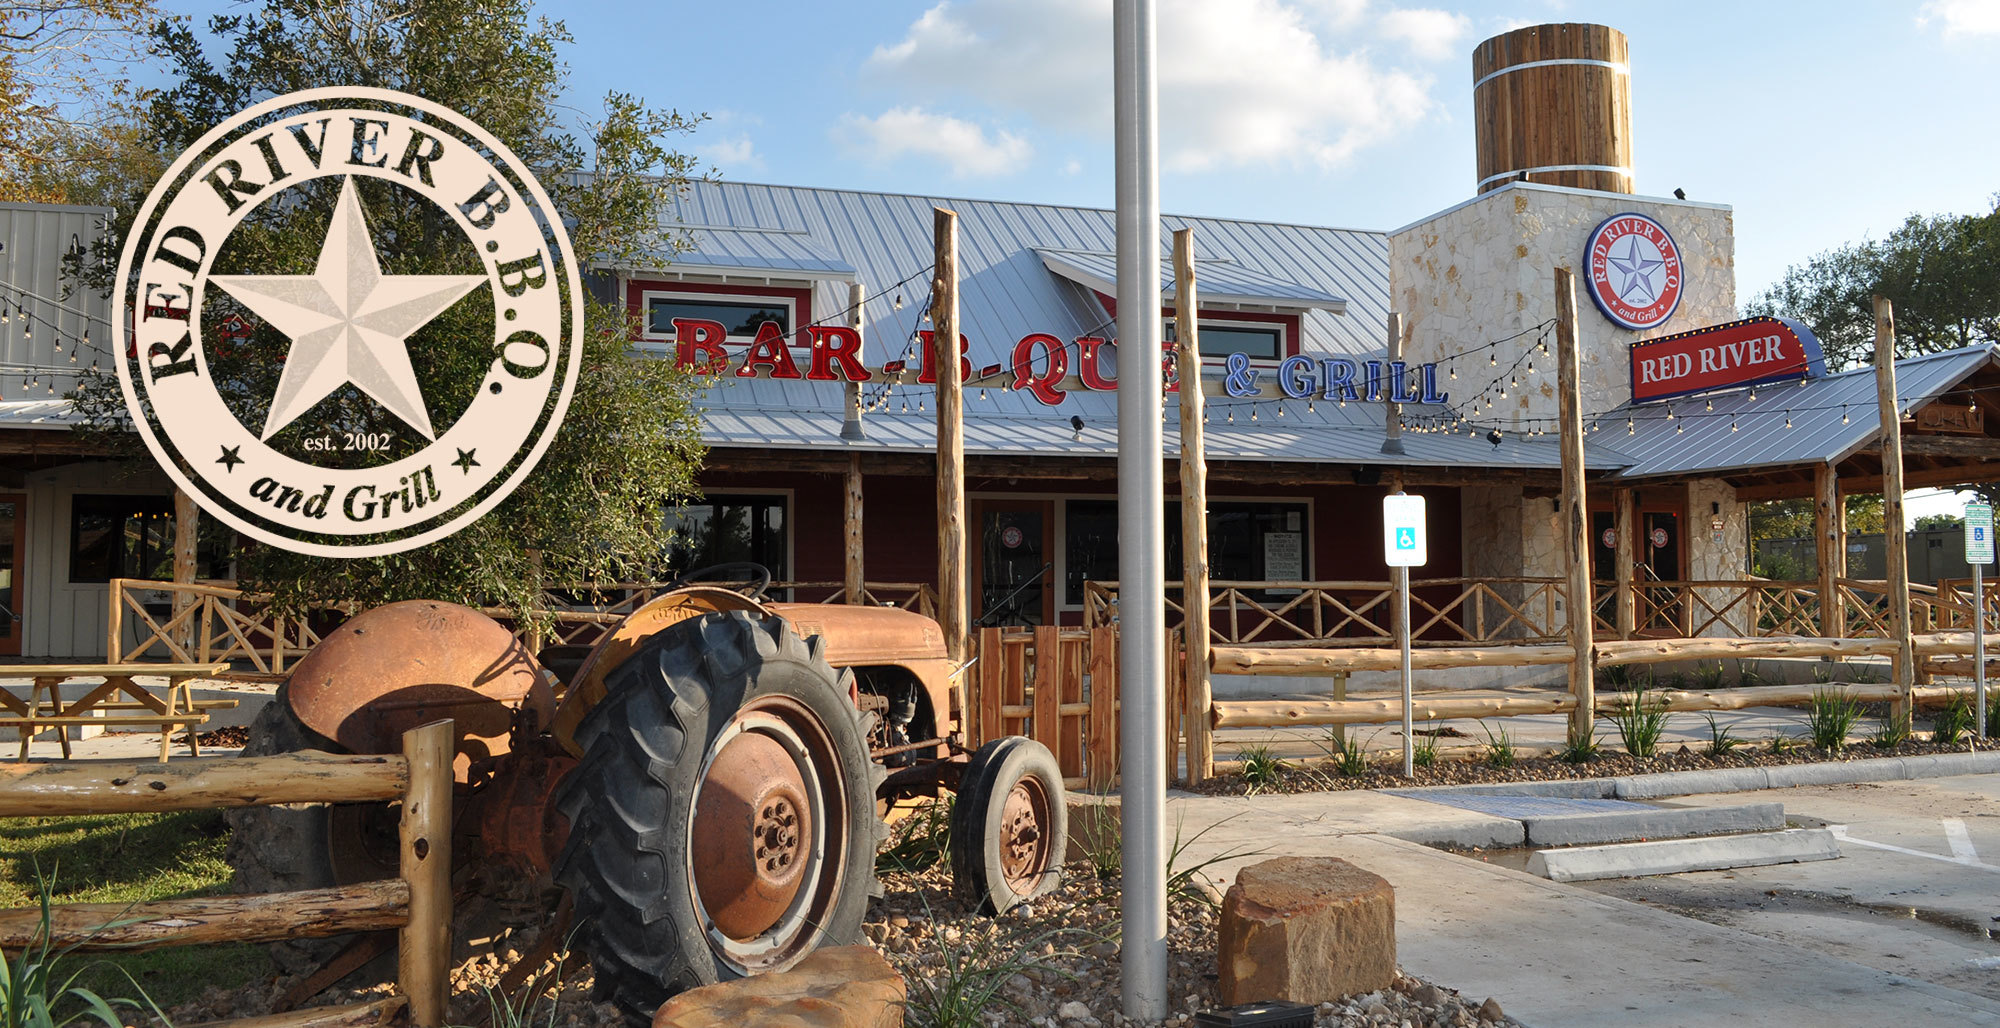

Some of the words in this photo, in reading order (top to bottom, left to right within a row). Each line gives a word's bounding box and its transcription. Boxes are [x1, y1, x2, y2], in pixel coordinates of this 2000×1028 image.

[1594, 244, 1608, 284] RED
[1604, 220, 1655, 242] RIVER
[1618, 307, 1636, 320] and
[1637, 308, 1658, 321] Grill
[1224, 352, 1263, 398] &
[1277, 353, 1449, 404] GRILL
[1641, 353, 1692, 384] RED
[1699, 335, 1785, 374] RIVER
